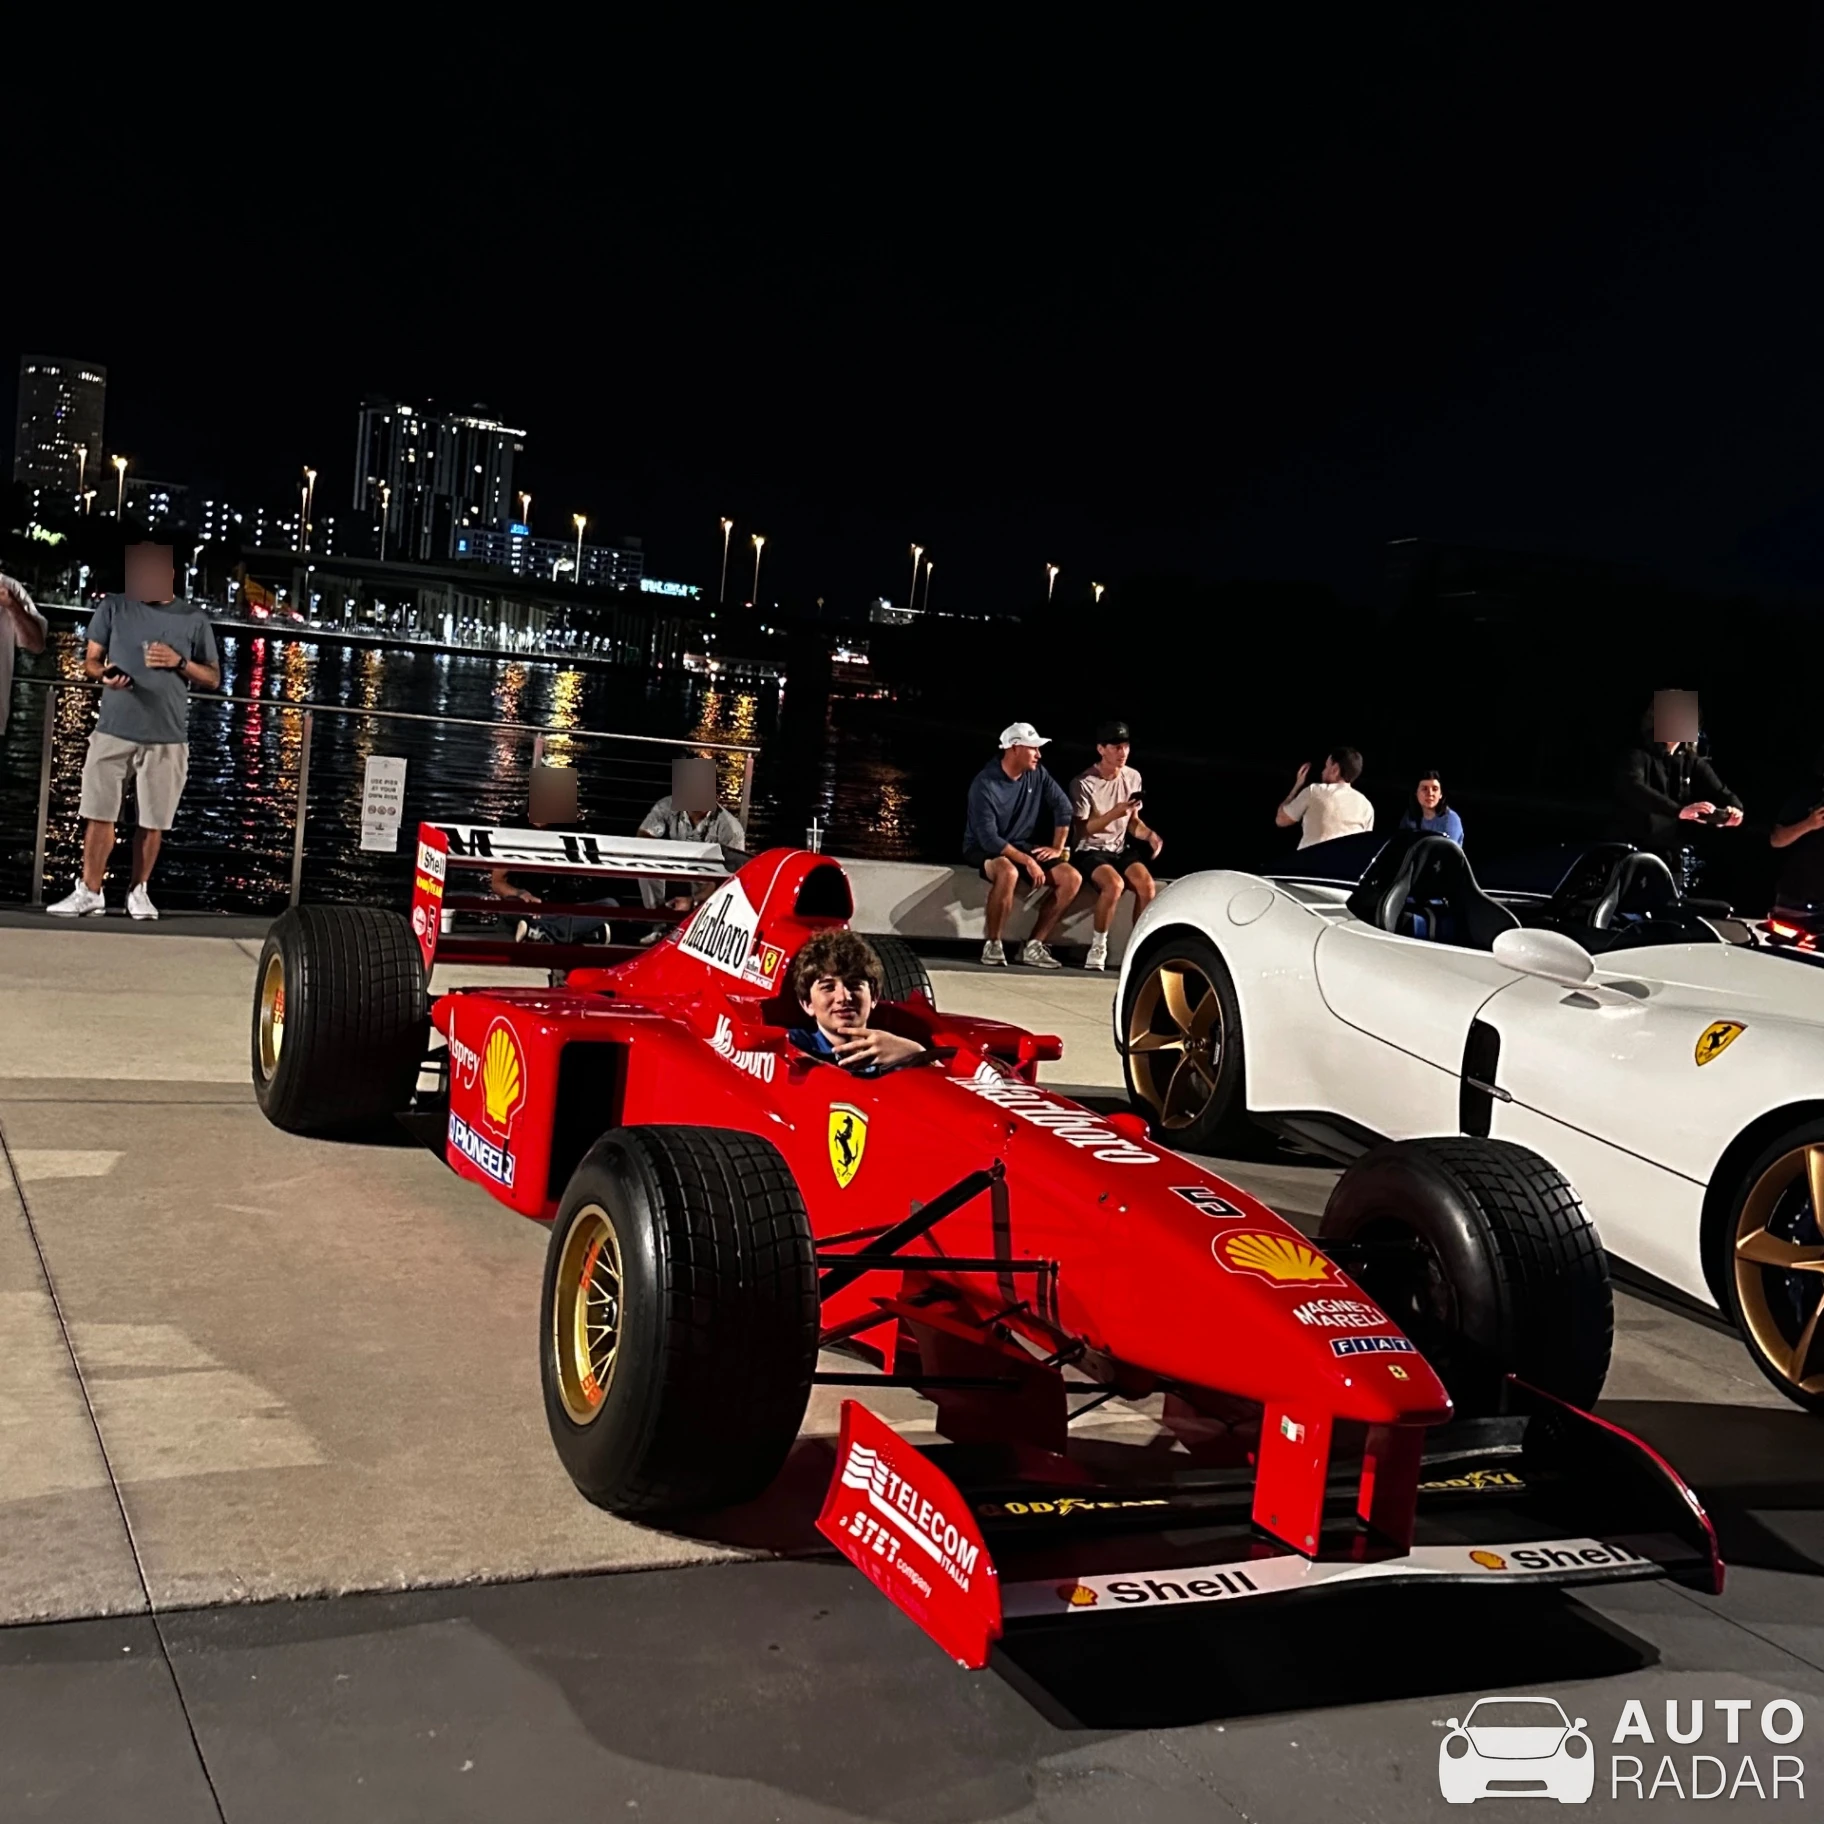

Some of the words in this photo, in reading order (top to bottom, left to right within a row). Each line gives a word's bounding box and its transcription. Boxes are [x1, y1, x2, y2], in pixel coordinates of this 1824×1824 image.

[424, 851, 445, 876] Shell
[427, 905, 437, 948] 5
[683, 893, 749, 969] Marlboro
[449, 1006, 480, 1090] Asprey
[945, 1076, 1160, 1164] Marlboro
[455, 1122, 513, 1184] PIONEER
[1169, 1186, 1246, 1218] 5
[1338, 1339, 1407, 1353] FIAT
[887, 1472, 979, 1575] TELECOM
[848, 1511, 901, 1563] STET
[896, 1558, 933, 1599] company
[941, 1555, 969, 1593] ITALIA
[1509, 1542, 1641, 1570] Shell
[1107, 1571, 1258, 1603] Shell
